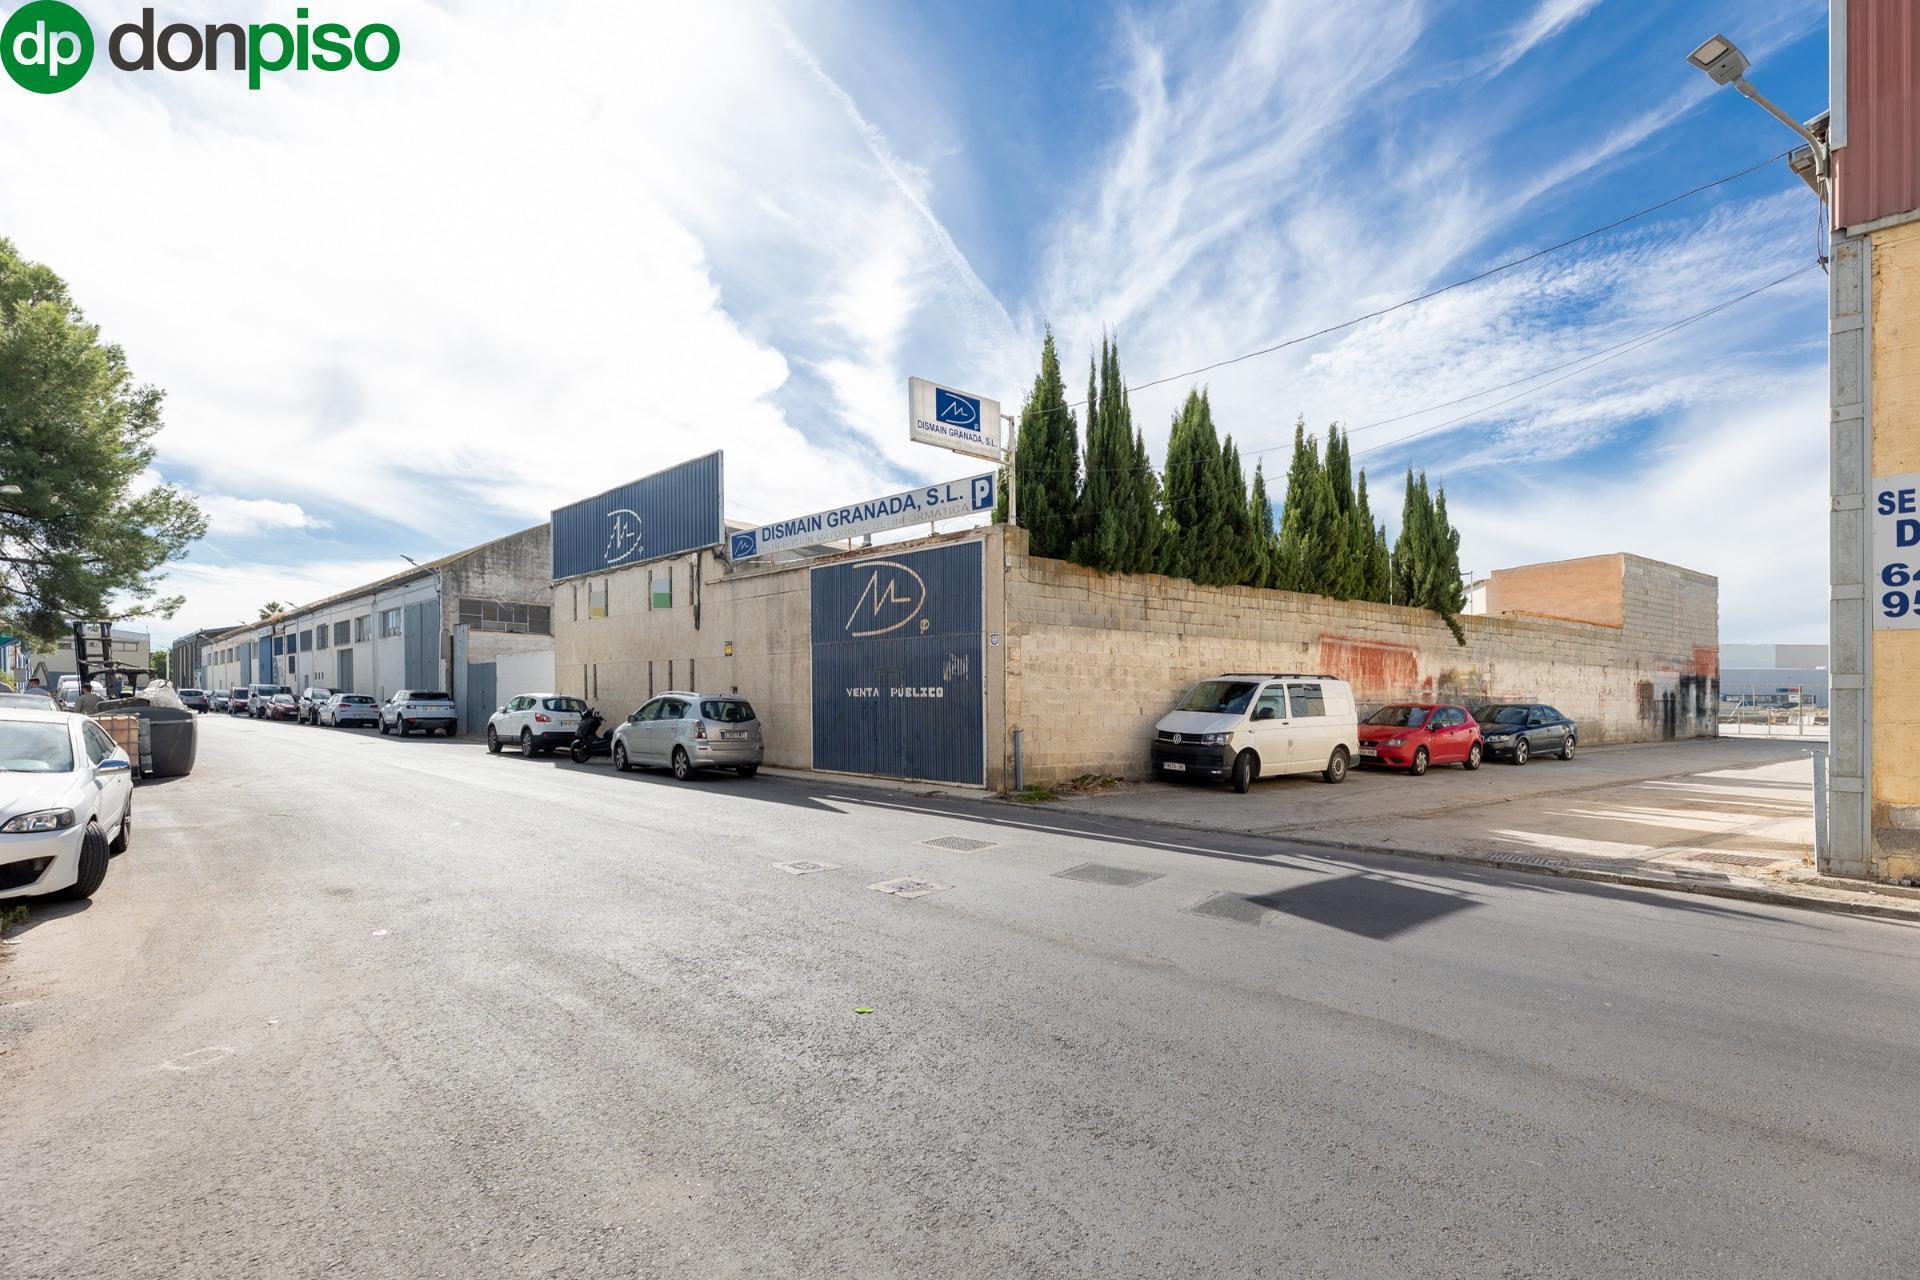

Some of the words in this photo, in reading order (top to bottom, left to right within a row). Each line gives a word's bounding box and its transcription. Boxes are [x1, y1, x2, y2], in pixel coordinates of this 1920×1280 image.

[917, 419, 947, 435] DISMAIN
[948, 428, 984, 445] GRANADA,
[985, 437, 998, 448] S.L.
[975, 479, 990, 507] P
[762, 514, 822, 542] DISMAIN
[827, 494, 921, 528] GRANADA,
[926, 484, 964, 506] S.L.
[1881, 563, 1920, 587] 6
[846, 687, 880, 698] VENTA
